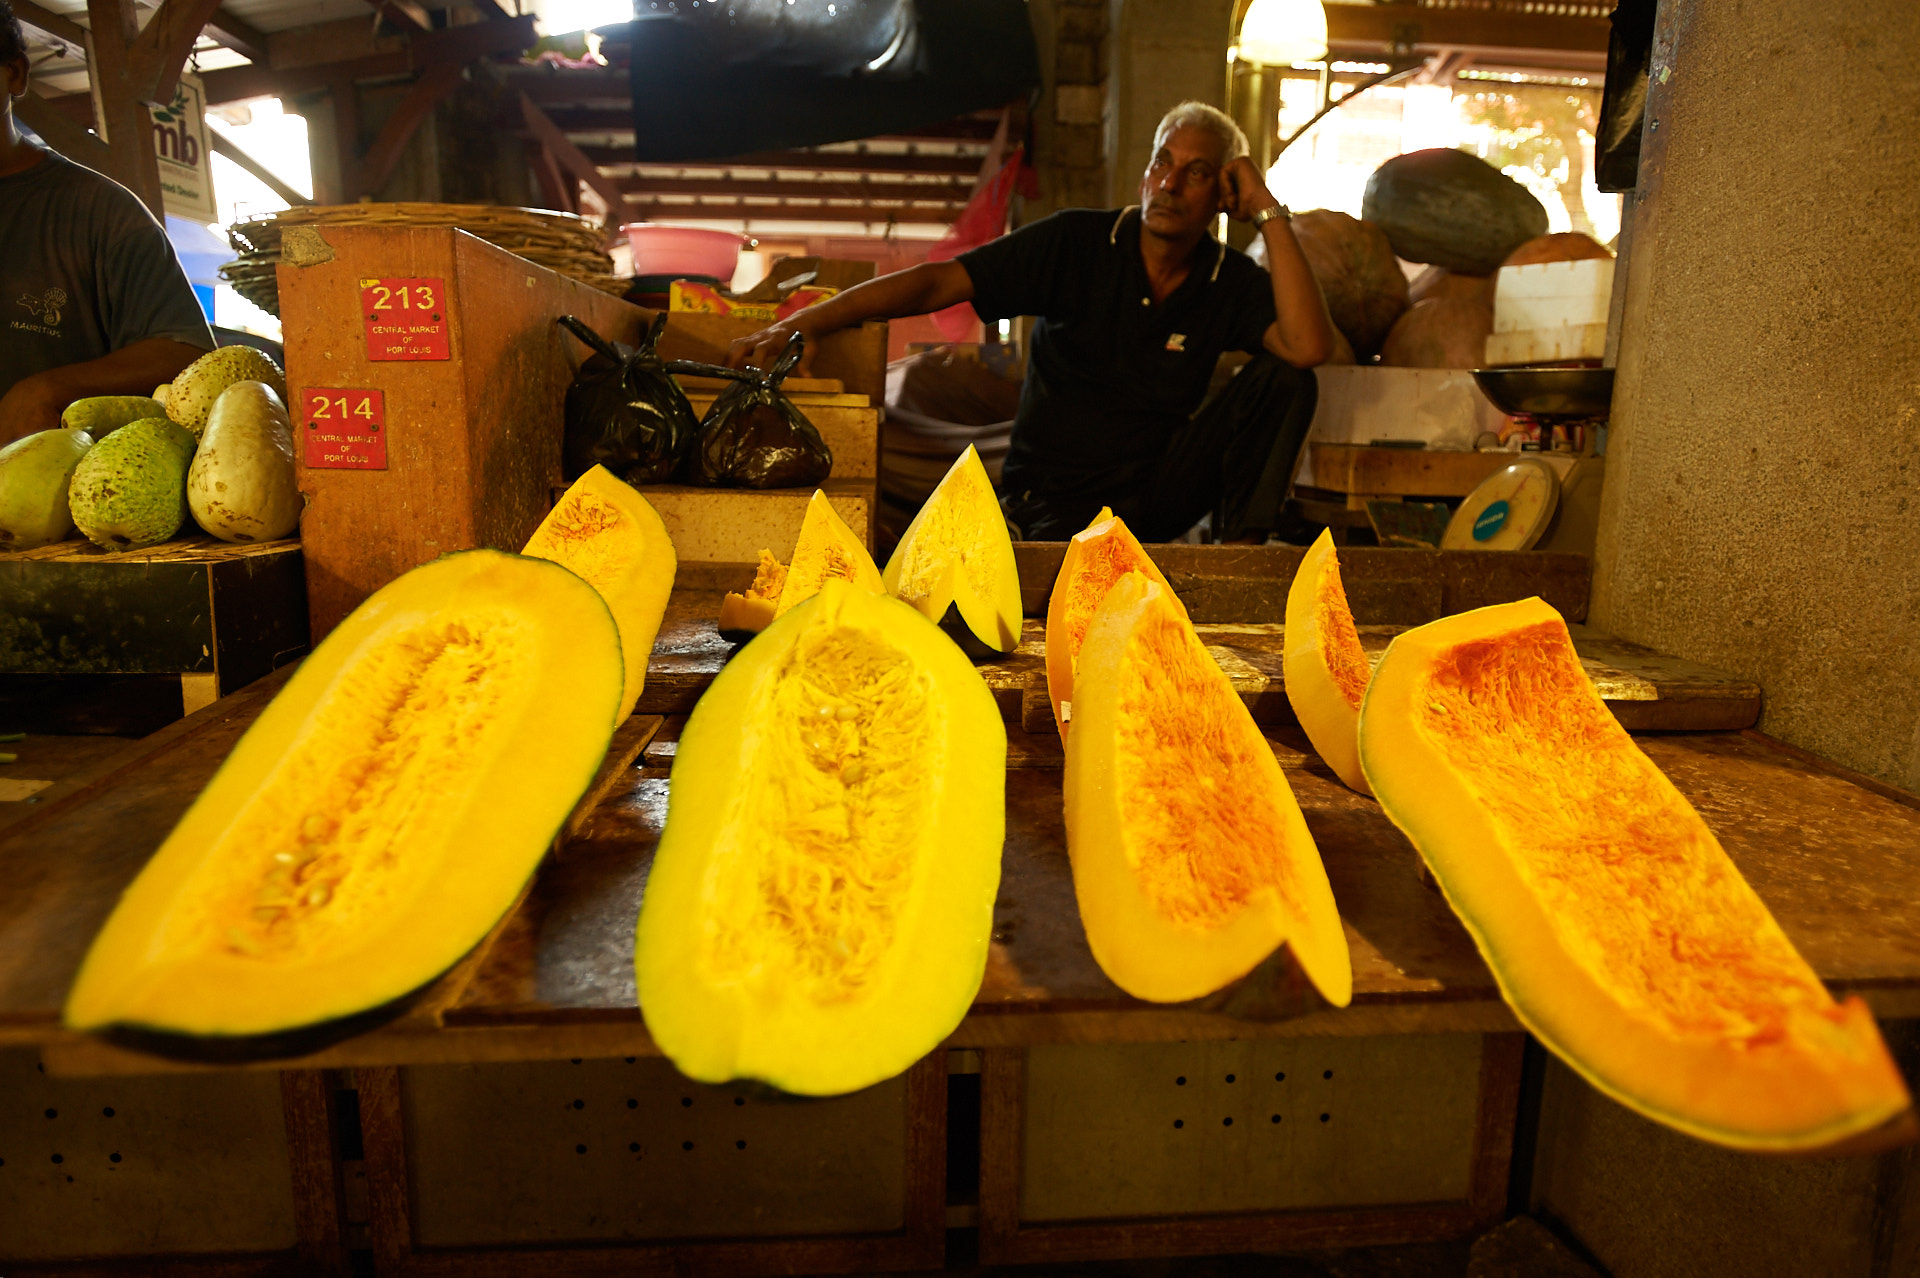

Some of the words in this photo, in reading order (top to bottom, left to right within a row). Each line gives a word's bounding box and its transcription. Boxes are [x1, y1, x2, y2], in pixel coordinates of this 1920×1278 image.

[372, 286, 435, 310] 213
[372, 326, 407, 334] CENTRAL
[409, 325, 440, 334] MARKET
[402, 336, 413, 344] OF
[386, 346, 406, 354] PORT
[409, 346, 432, 354] LOUIS
[311, 396, 374, 420] 214
[311, 434, 345, 443] CENTRAL
[340, 445, 351, 453] OF
[324, 454, 344, 462] PORT
[346, 455, 369, 463] LOUIS
